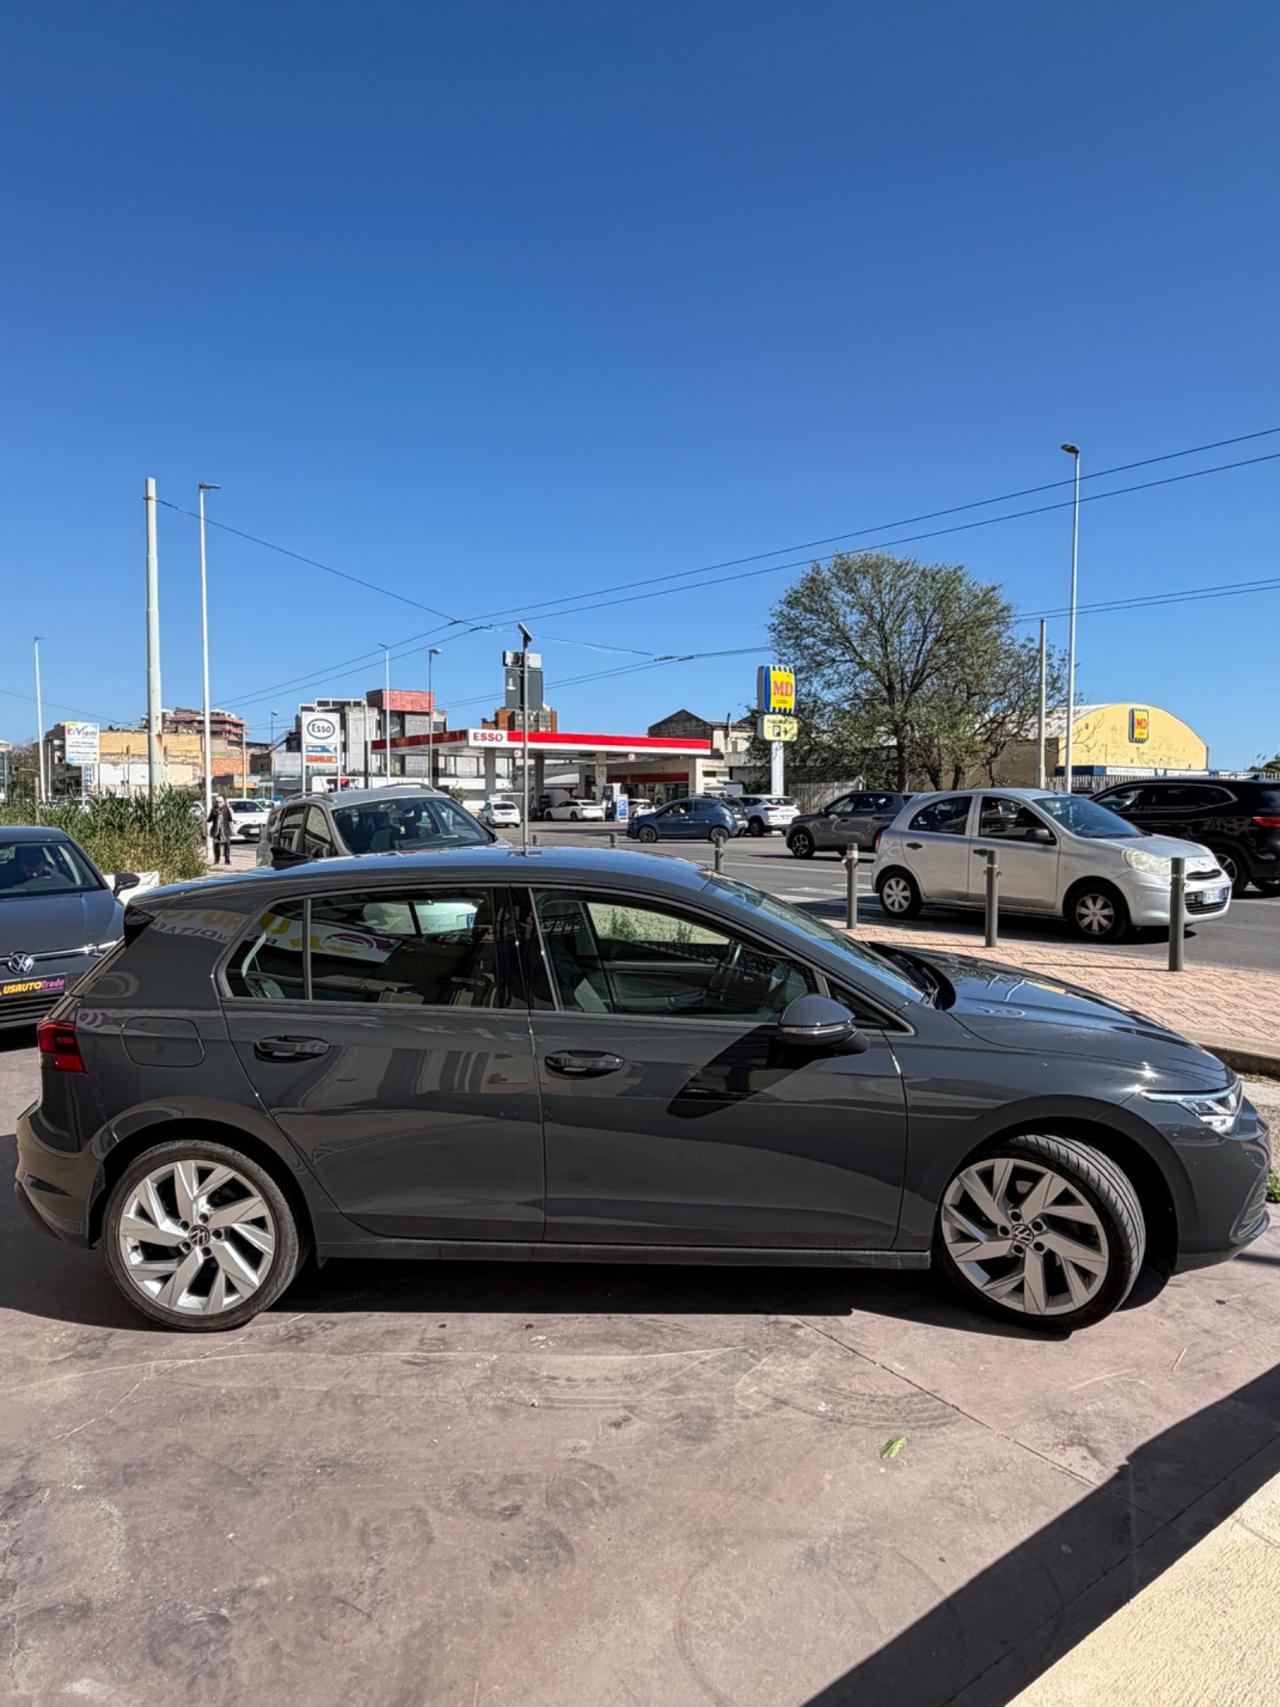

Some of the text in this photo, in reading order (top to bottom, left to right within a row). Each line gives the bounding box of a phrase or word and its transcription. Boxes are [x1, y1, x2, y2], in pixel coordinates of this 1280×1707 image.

[773, 681, 793, 696] MD
[312, 724, 331, 733] Esso
[473, 732, 503, 742] ESSO
